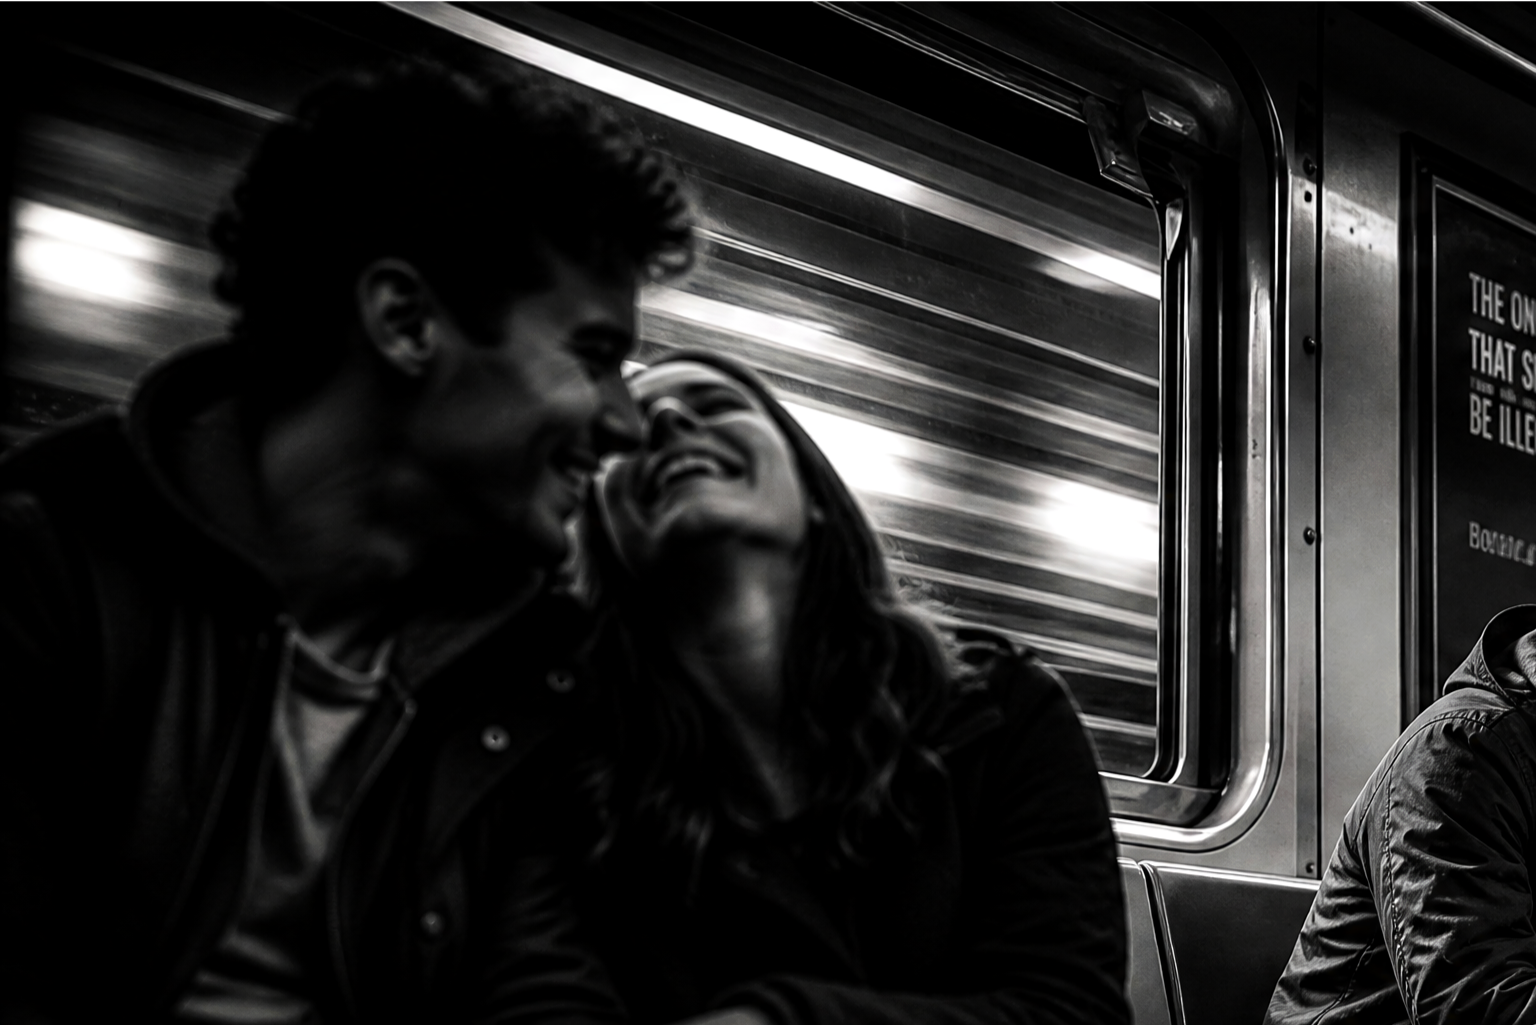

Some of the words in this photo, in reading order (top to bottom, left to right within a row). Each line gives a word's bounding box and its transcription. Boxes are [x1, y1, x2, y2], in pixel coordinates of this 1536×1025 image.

[1468, 271, 1505, 326] THE
[1468, 327, 1516, 383] THAT
[1469, 393, 1494, 441] BE
